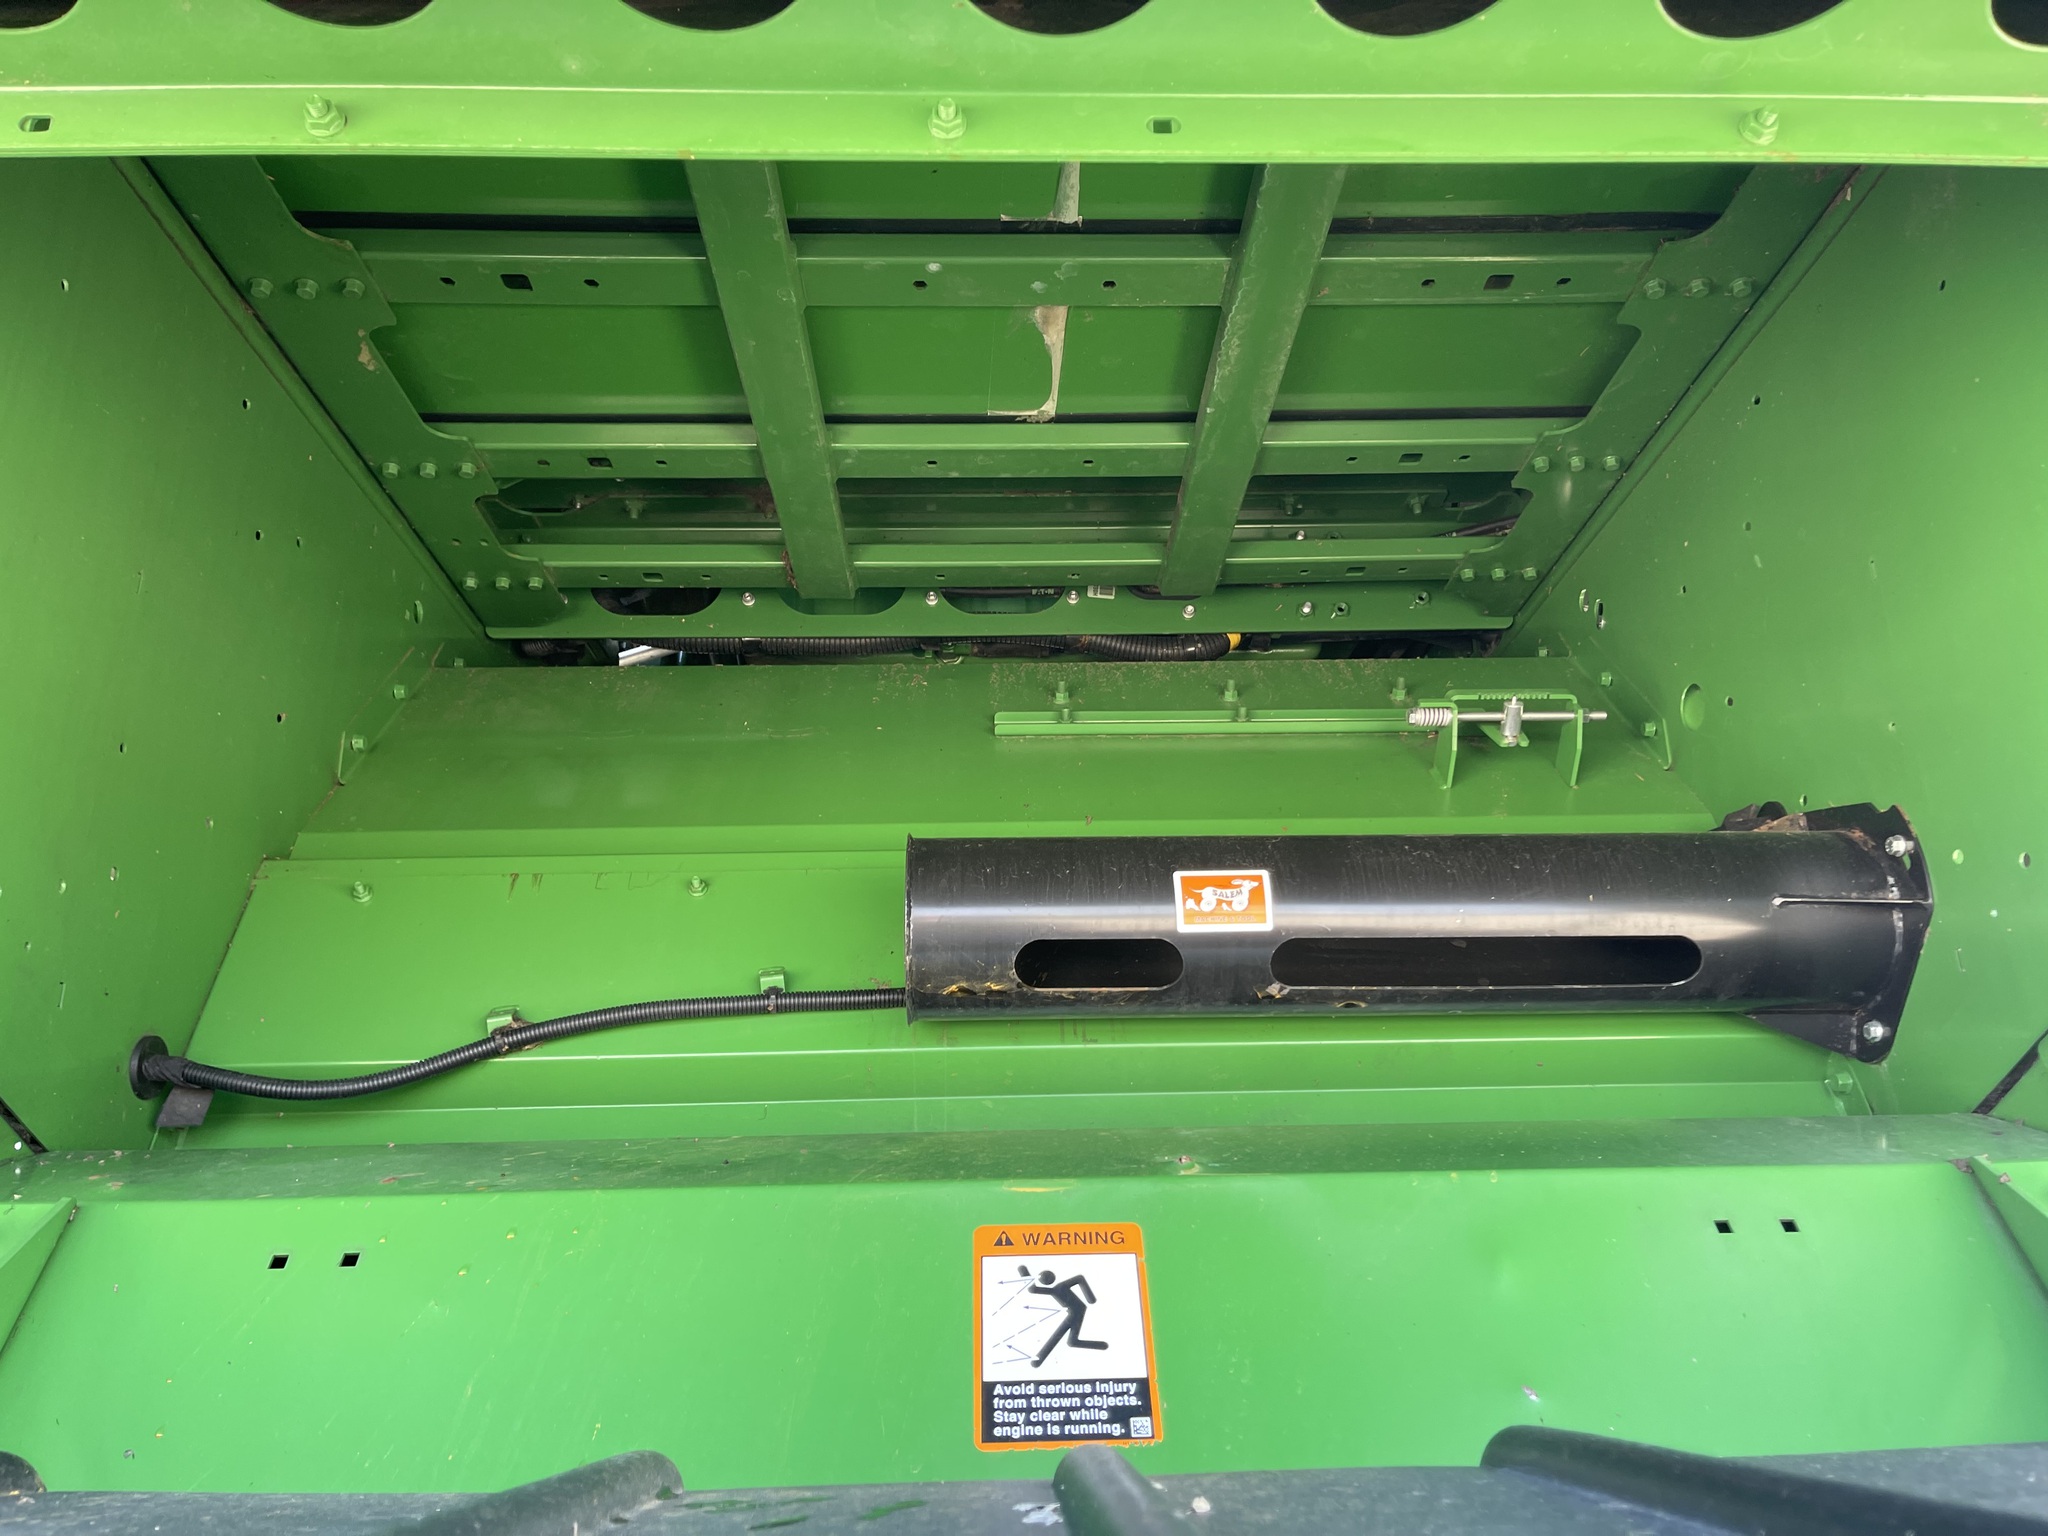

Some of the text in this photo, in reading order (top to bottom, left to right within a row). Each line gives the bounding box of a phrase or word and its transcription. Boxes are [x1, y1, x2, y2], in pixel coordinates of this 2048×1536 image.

[1212, 888, 1243, 899] SALEM
[1022, 1230, 1125, 1247] WARNING
[993, 1381, 1137, 1398] Avoid serious injury
[992, 1394, 1142, 1410] from thrown objects.
[993, 1408, 1108, 1425] Stay clear while
[993, 1422, 1126, 1439] engine is running.
